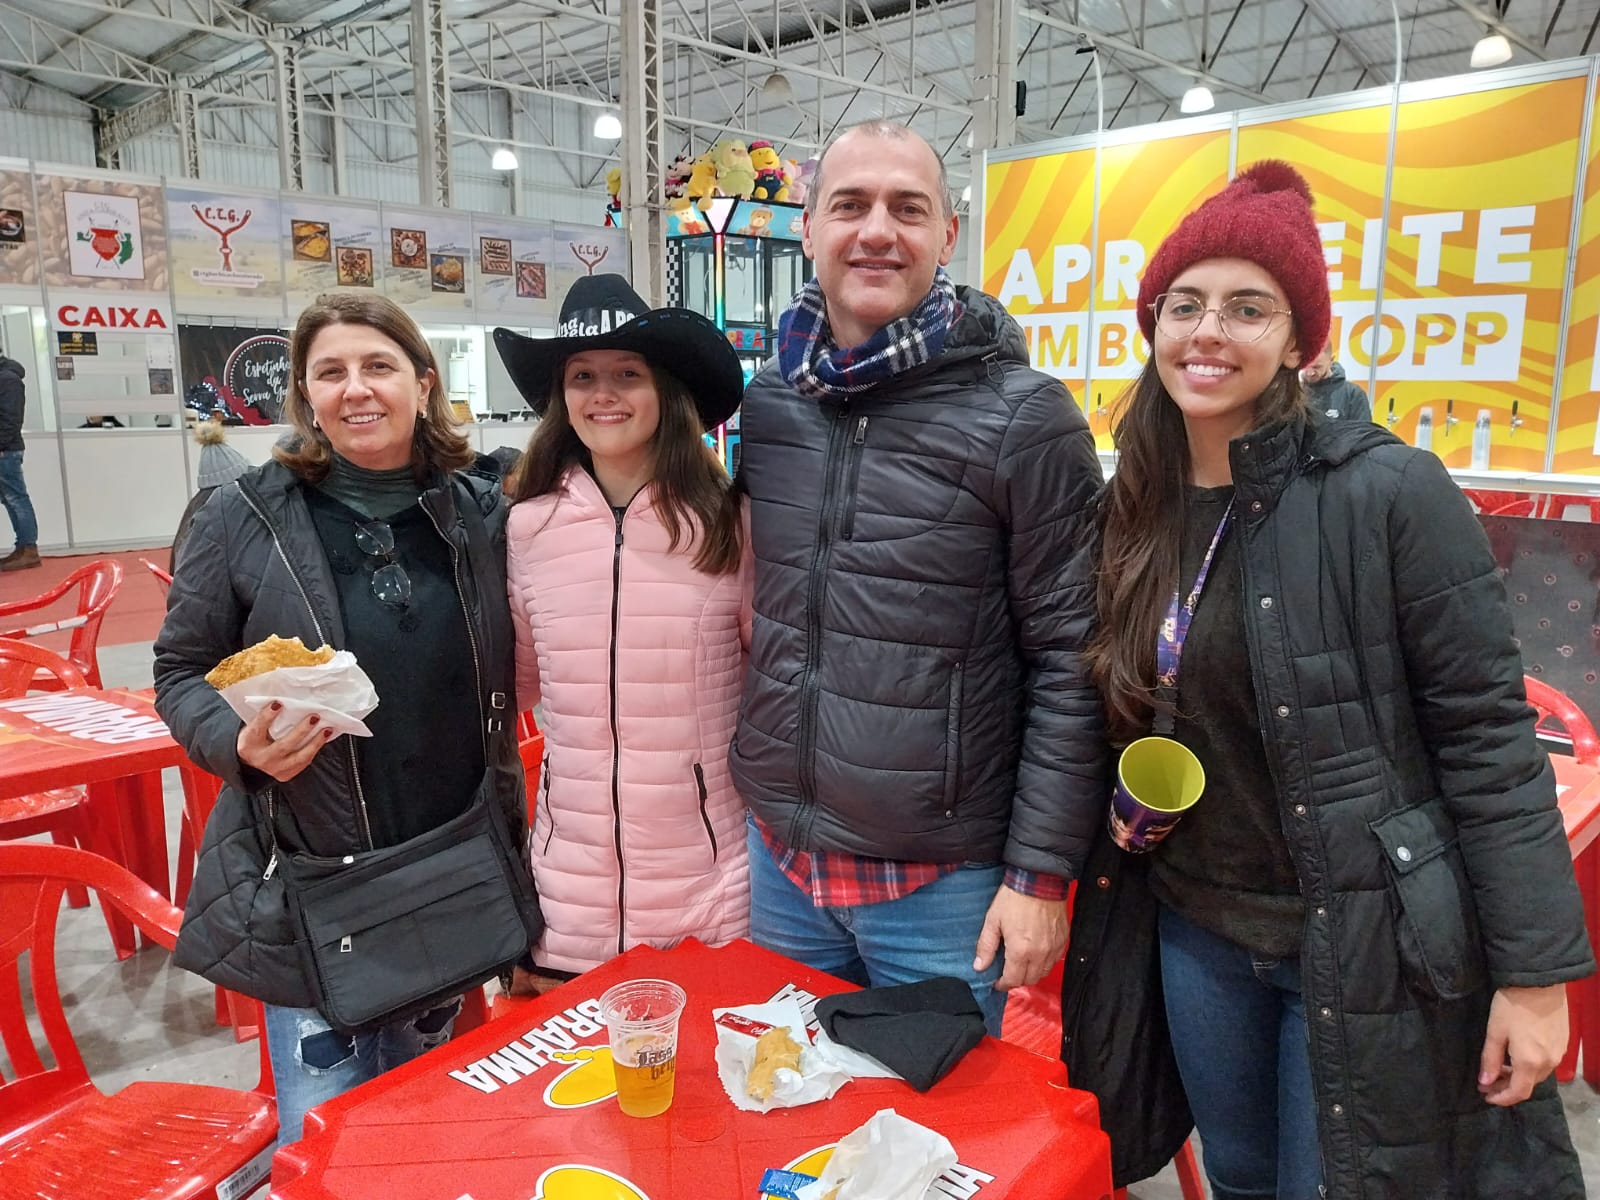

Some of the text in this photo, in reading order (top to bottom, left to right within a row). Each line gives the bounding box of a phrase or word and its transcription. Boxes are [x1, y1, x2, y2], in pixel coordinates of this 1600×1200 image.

[998, 205, 1536, 306] APREITE
[57, 305, 167, 329] CAIXA
[1331, 311, 1508, 367] OPP
[448, 997, 618, 1094] BRAHMA
